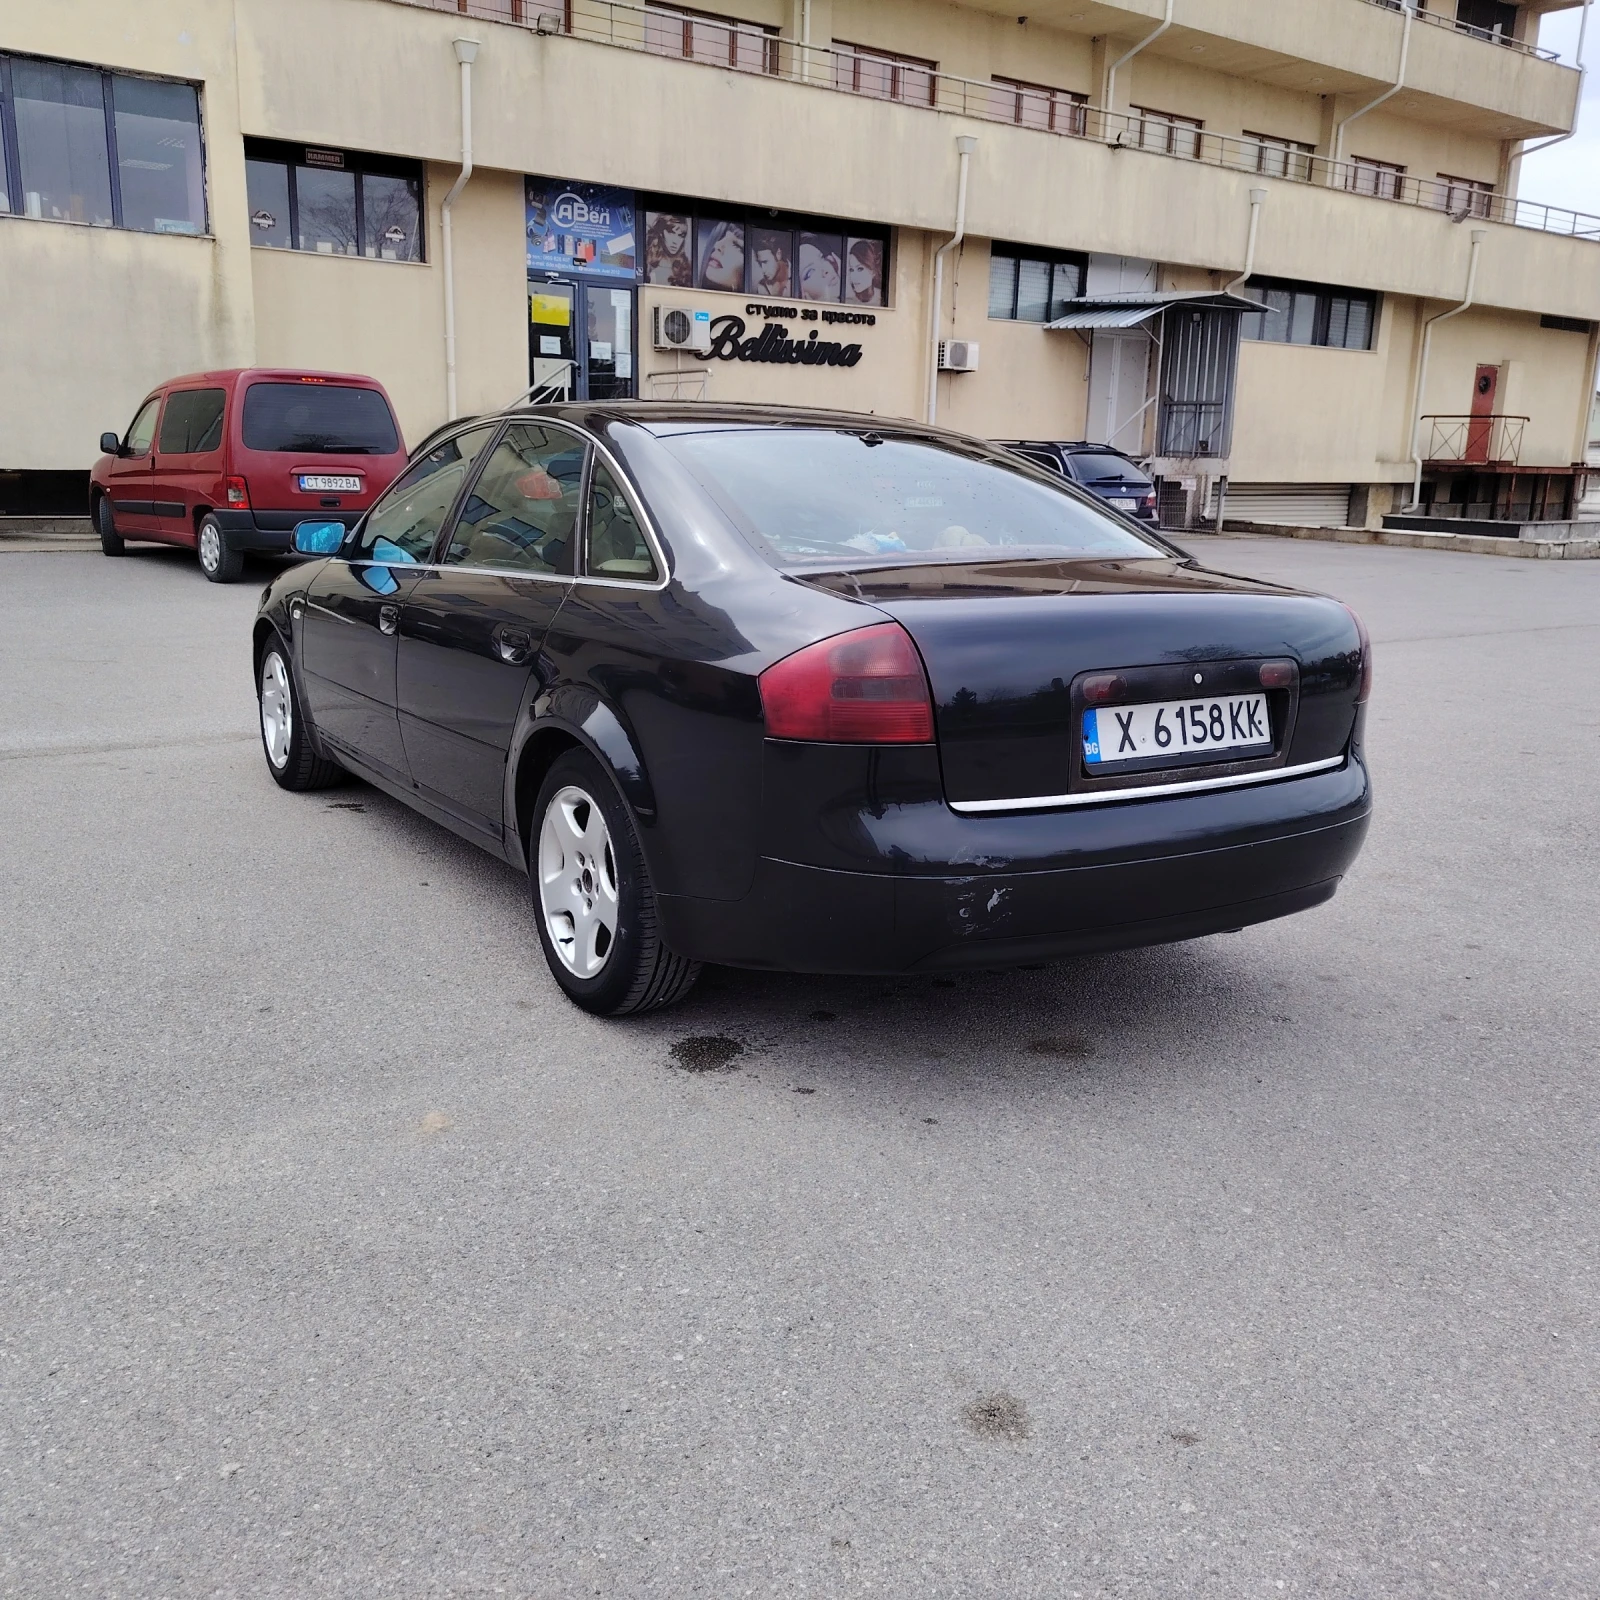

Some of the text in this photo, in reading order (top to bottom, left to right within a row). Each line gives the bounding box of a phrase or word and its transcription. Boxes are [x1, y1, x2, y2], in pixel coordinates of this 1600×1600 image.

[745, 303, 876, 325] студио за красота
[694, 315, 863, 367] Bellissima
[1085, 742, 1099, 755] BG
